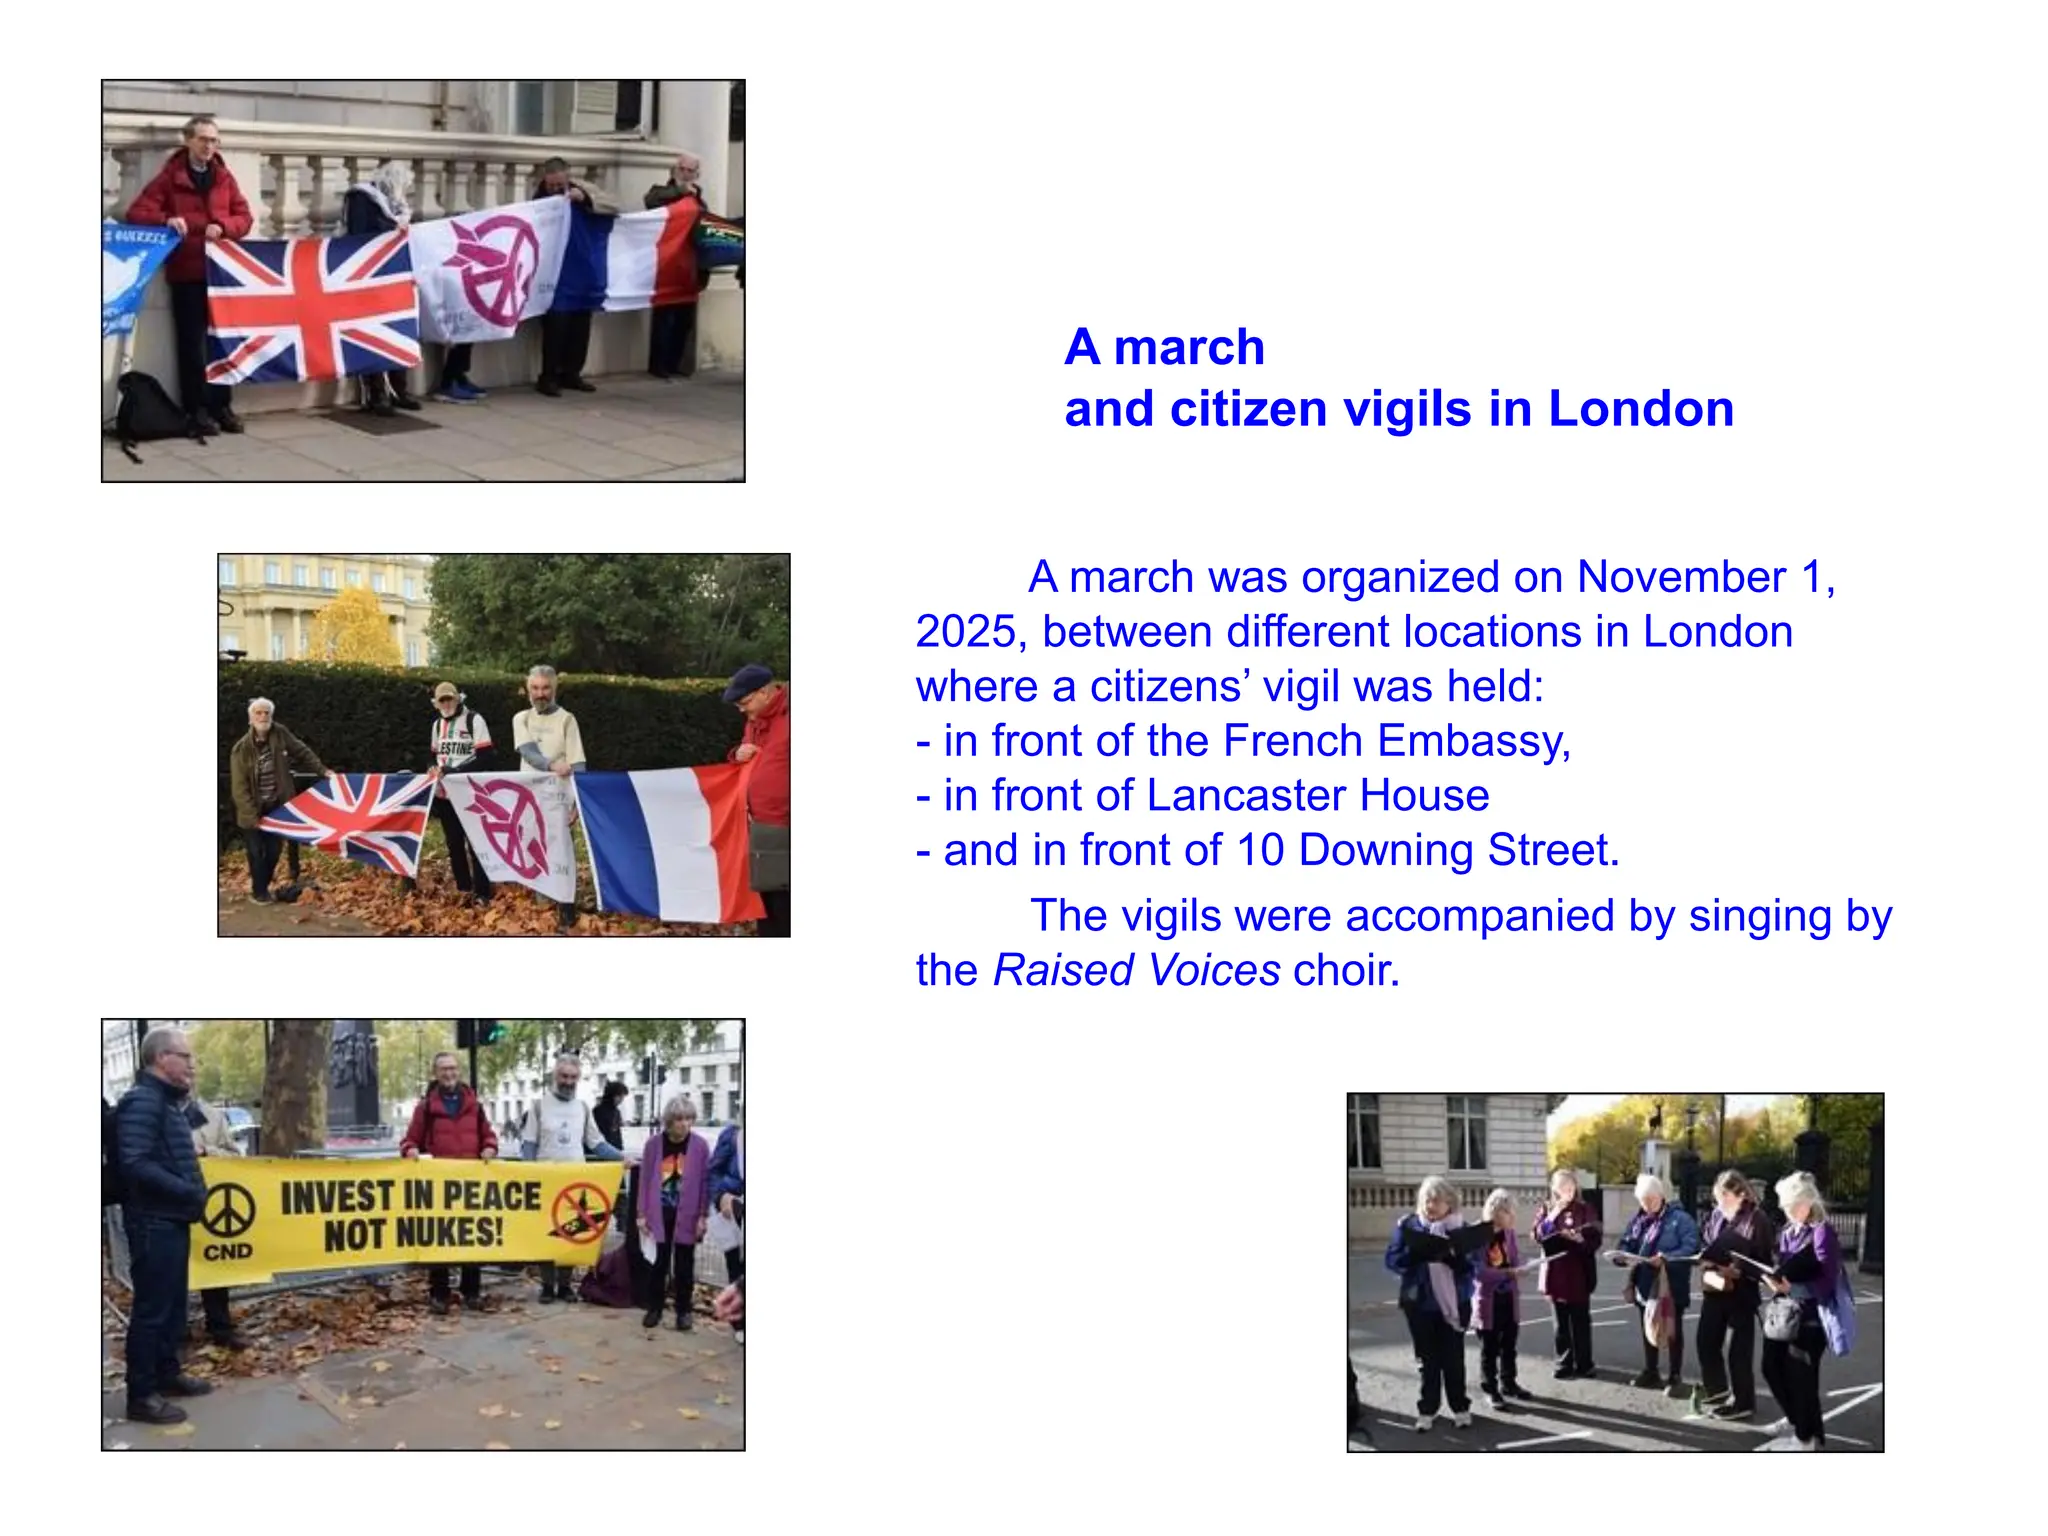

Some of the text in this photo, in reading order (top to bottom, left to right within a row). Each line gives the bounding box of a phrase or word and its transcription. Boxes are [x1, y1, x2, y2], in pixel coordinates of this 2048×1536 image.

[438, 741, 473, 755] ESTINE
[281, 1180, 541, 1215] INVEST IN PEACE
[324, 1216, 503, 1253] NOT NUKES!
[203, 1243, 253, 1261] CND
